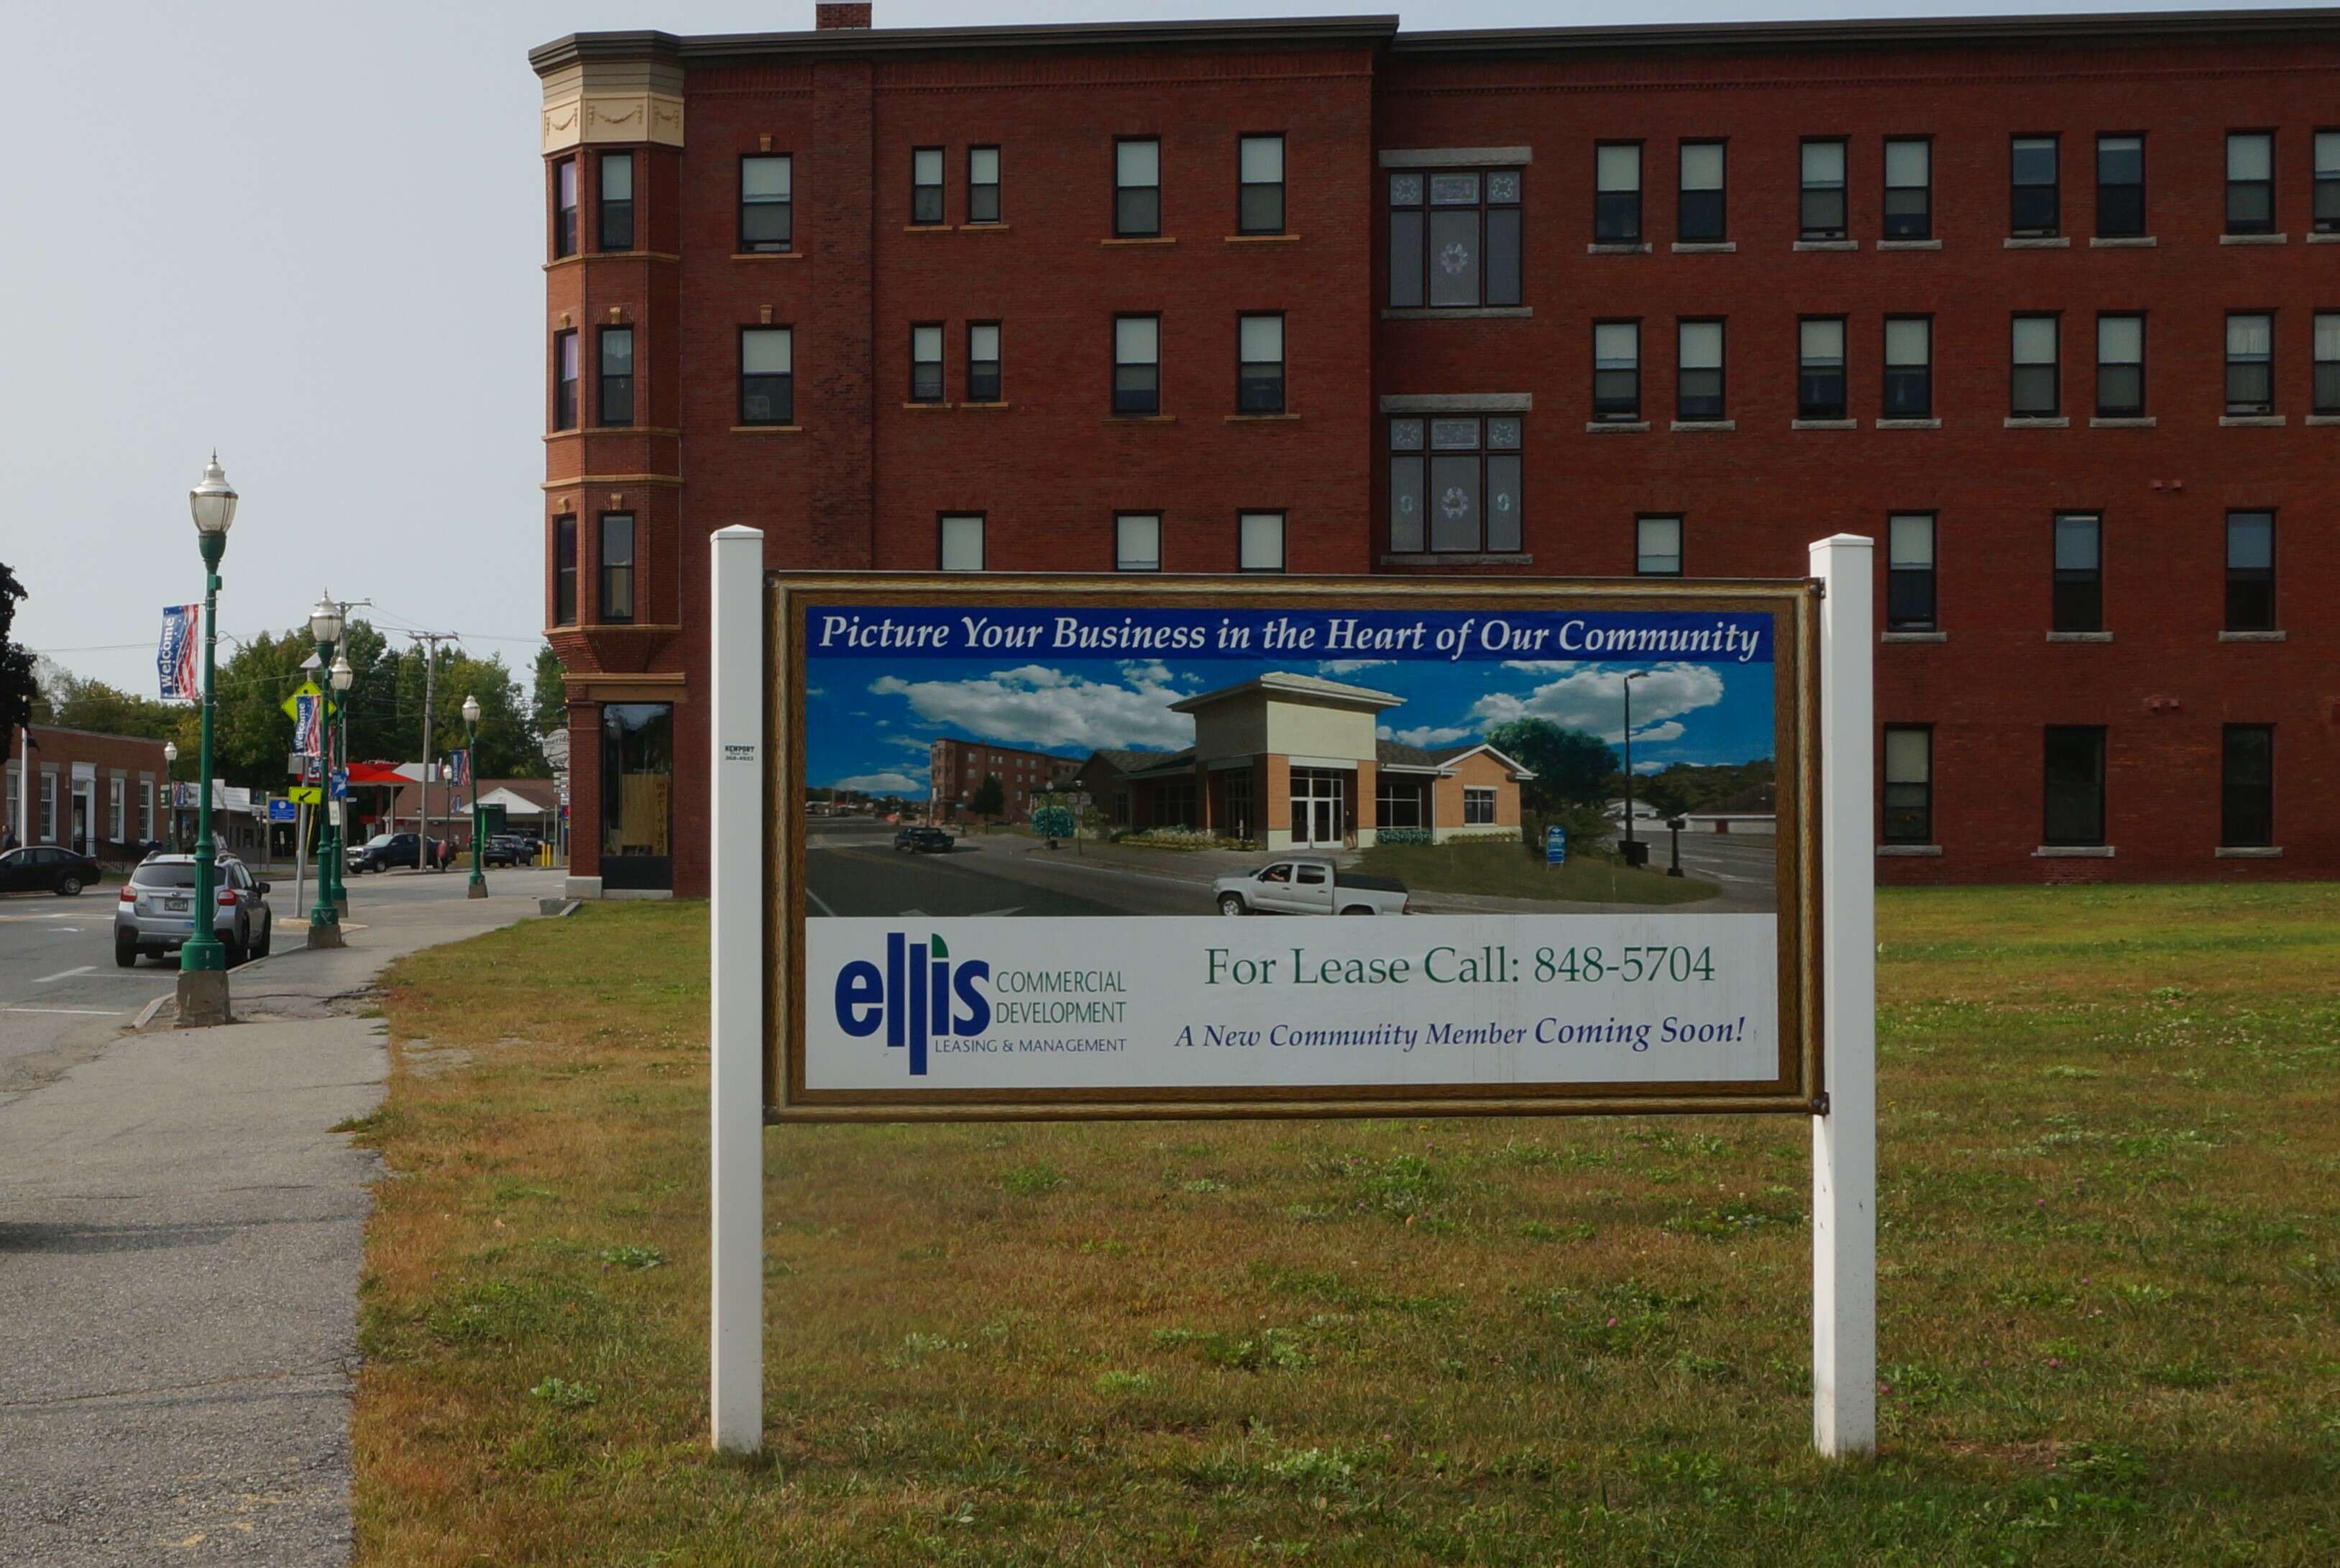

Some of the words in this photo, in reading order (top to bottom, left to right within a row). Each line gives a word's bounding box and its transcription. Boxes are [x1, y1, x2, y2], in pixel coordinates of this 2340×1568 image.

[160, 617, 175, 687] Welcome
[819, 616, 950, 647] Picture
[961, 616, 1043, 648] Your
[1052, 617, 1206, 648] Business
[1217, 618, 1250, 648] in
[1262, 618, 1316, 649] the
[1324, 619, 1426, 650] Heart
[1436, 618, 1474, 659] of
[1481, 620, 1549, 650] Our
[1559, 620, 1760, 659] Community
[296, 703, 306, 749] Welcome
[996, 971, 1127, 994] COMMERCIAL
[1204, 948, 1277, 985] For
[1290, 948, 1410, 984] Lease
[1423, 945, 1519, 984] Call:
[1534, 945, 1716, 984] 848-5704
[835, 932, 991, 1076] ellis
[996, 1001, 1127, 1024] DEVELOPMENT
[934, 1039, 997, 1053] LEASING
[1002, 1039, 1014, 1053] &
[1019, 1038, 1127, 1053] MANAGEMENT
[1173, 1024, 1195, 1047] A
[1202, 1024, 1261, 1047] New
[1270, 1022, 1418, 1053] Community
[1424, 1022, 1528, 1045] Member
[1535, 1017, 1653, 1053] Coming
[1660, 1016, 1746, 1043] Soon!
